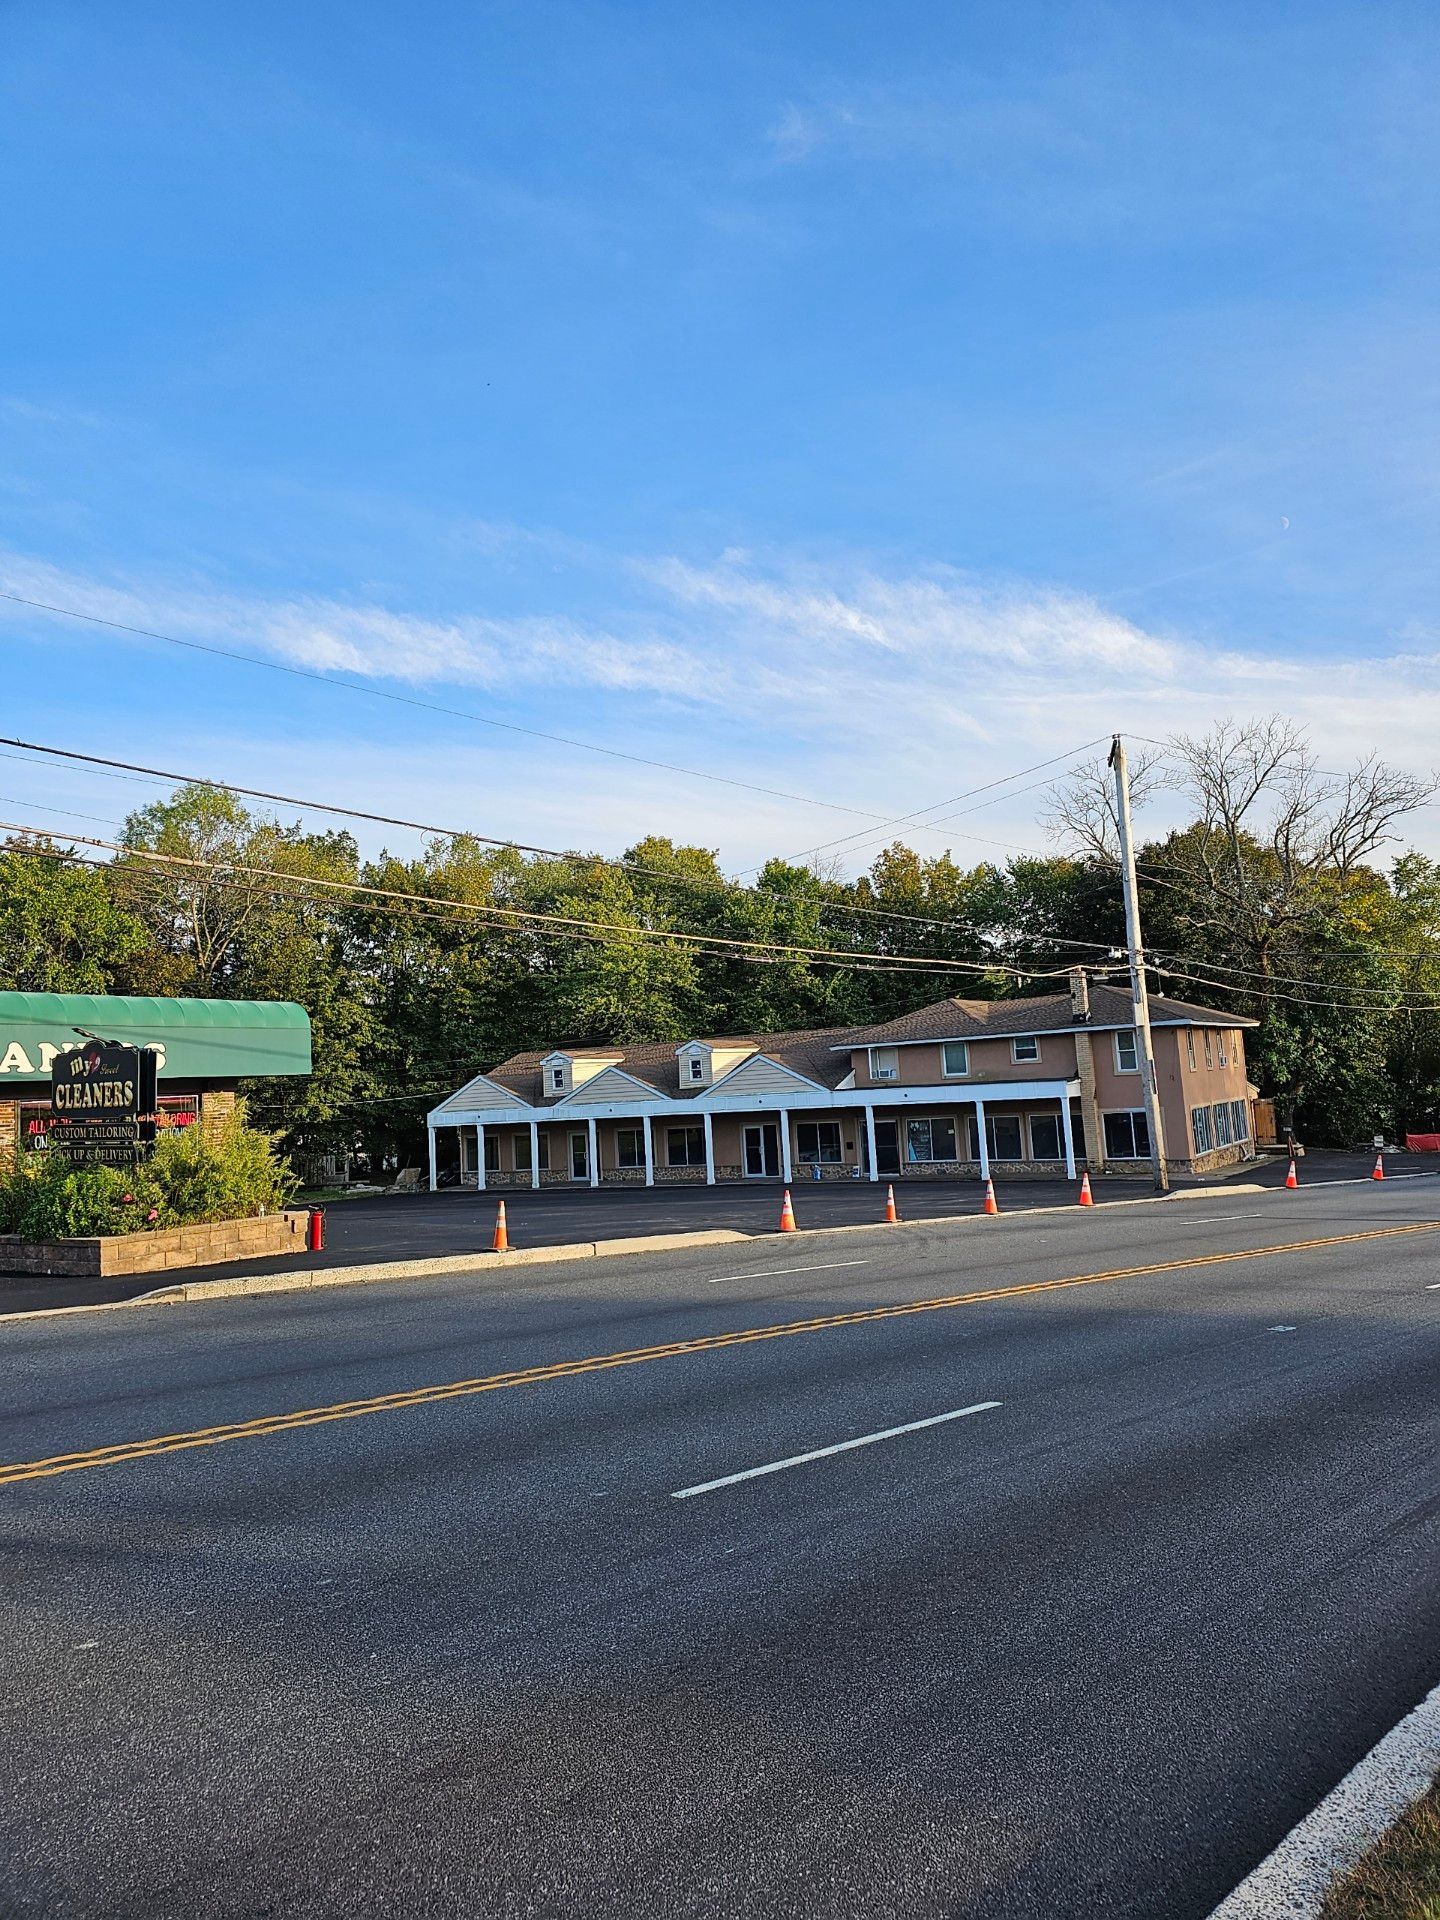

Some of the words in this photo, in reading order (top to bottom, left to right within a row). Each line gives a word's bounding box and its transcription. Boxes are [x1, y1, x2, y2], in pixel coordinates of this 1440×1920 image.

[55, 1080, 134, 1110] CLEANERS
[28, 1120, 47, 1134] ALL
[54, 1127, 87, 1139] CUSTOM
[88, 1126, 134, 1138] TAILORING
[73, 1149, 85, 1160] UP
[95, 1149, 133, 1160] DELIVERY
